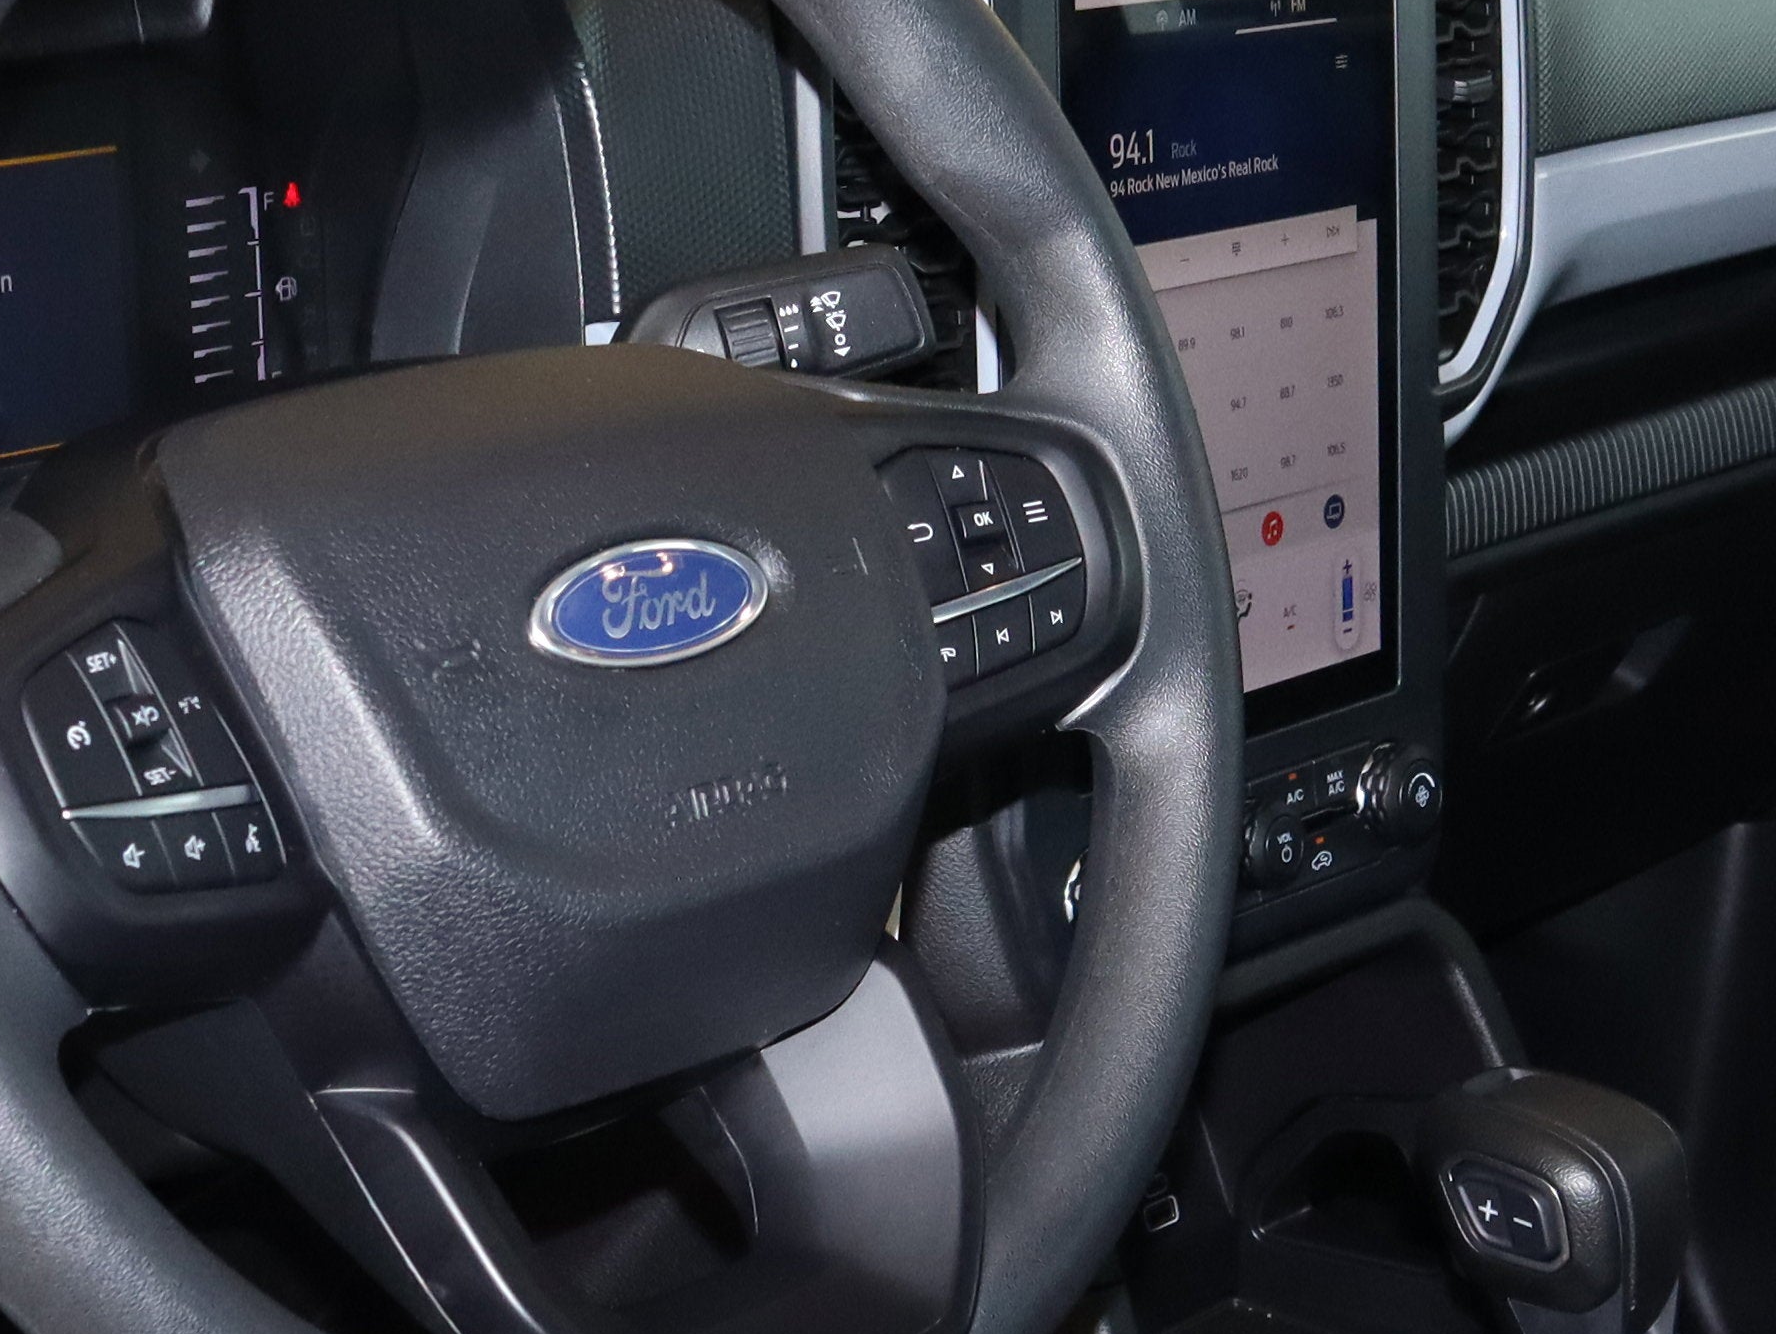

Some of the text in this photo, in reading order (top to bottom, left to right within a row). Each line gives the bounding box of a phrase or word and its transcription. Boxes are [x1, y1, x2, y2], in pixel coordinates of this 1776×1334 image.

[1178, 9, 1196, 27] AM
[1110, 129, 1197, 169] 94.1 Rock
[1110, 154, 1279, 198] 94 Rock New Mexico's Real Rock
[974, 511, 993, 527] OK
[601, 553, 716, 639] Ford
[85, 651, 117, 674] SET+
[1326, 770, 1344, 783] MAX
[1286, 788, 1305, 805] A/C
[1328, 781, 1345, 796] A/C
[1277, 832, 1293, 844] VOL
